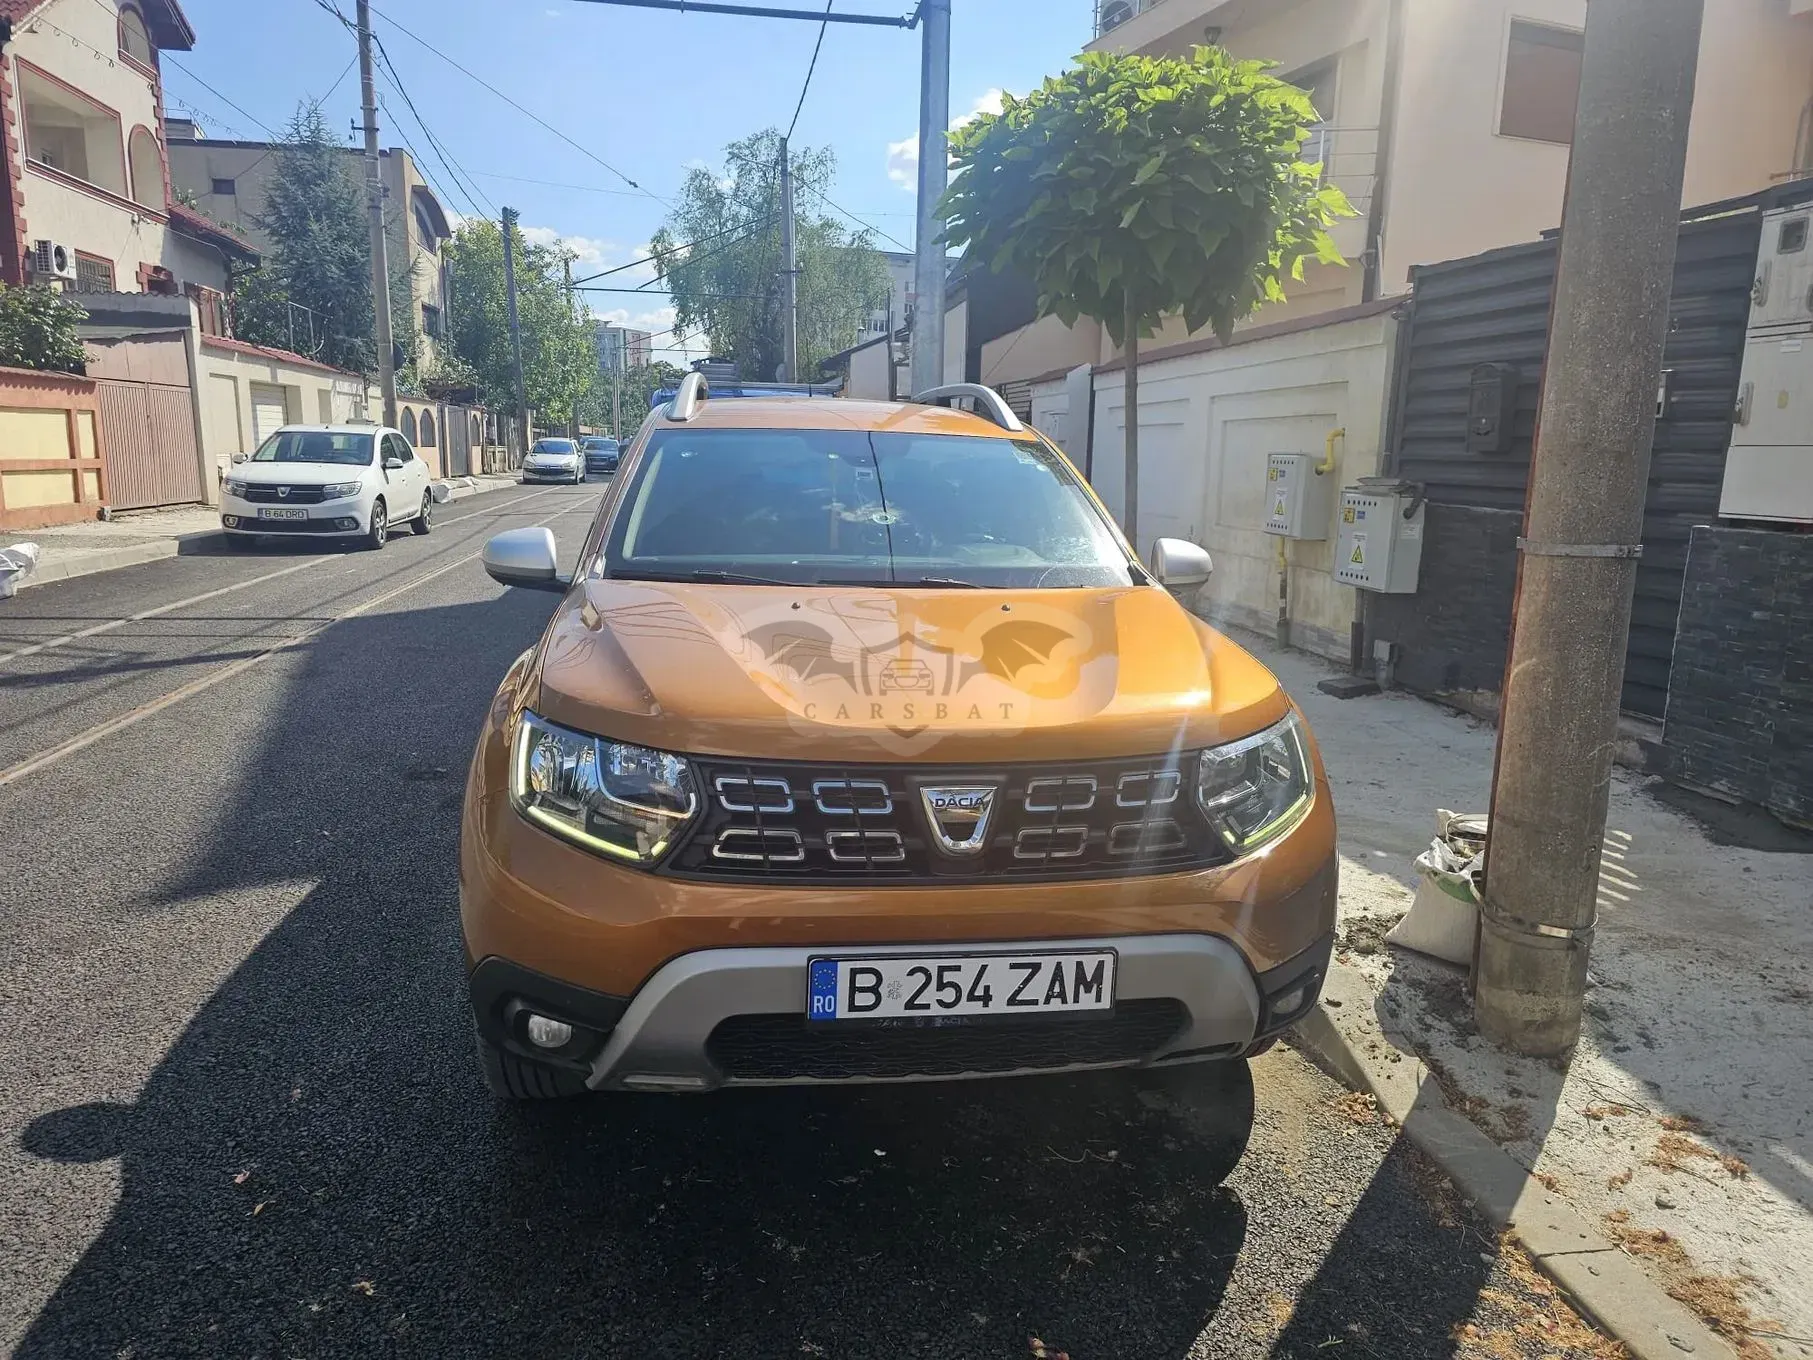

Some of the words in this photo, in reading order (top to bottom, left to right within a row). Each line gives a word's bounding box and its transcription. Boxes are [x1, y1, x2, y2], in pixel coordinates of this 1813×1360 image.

[265, 510, 271, 518] B
[935, 797, 984, 808] DACIA
[848, 967, 883, 1012] B
[904, 964, 993, 1010] 254
[1006, 960, 1105, 1006] ZAM
[814, 995, 834, 1013] RO
